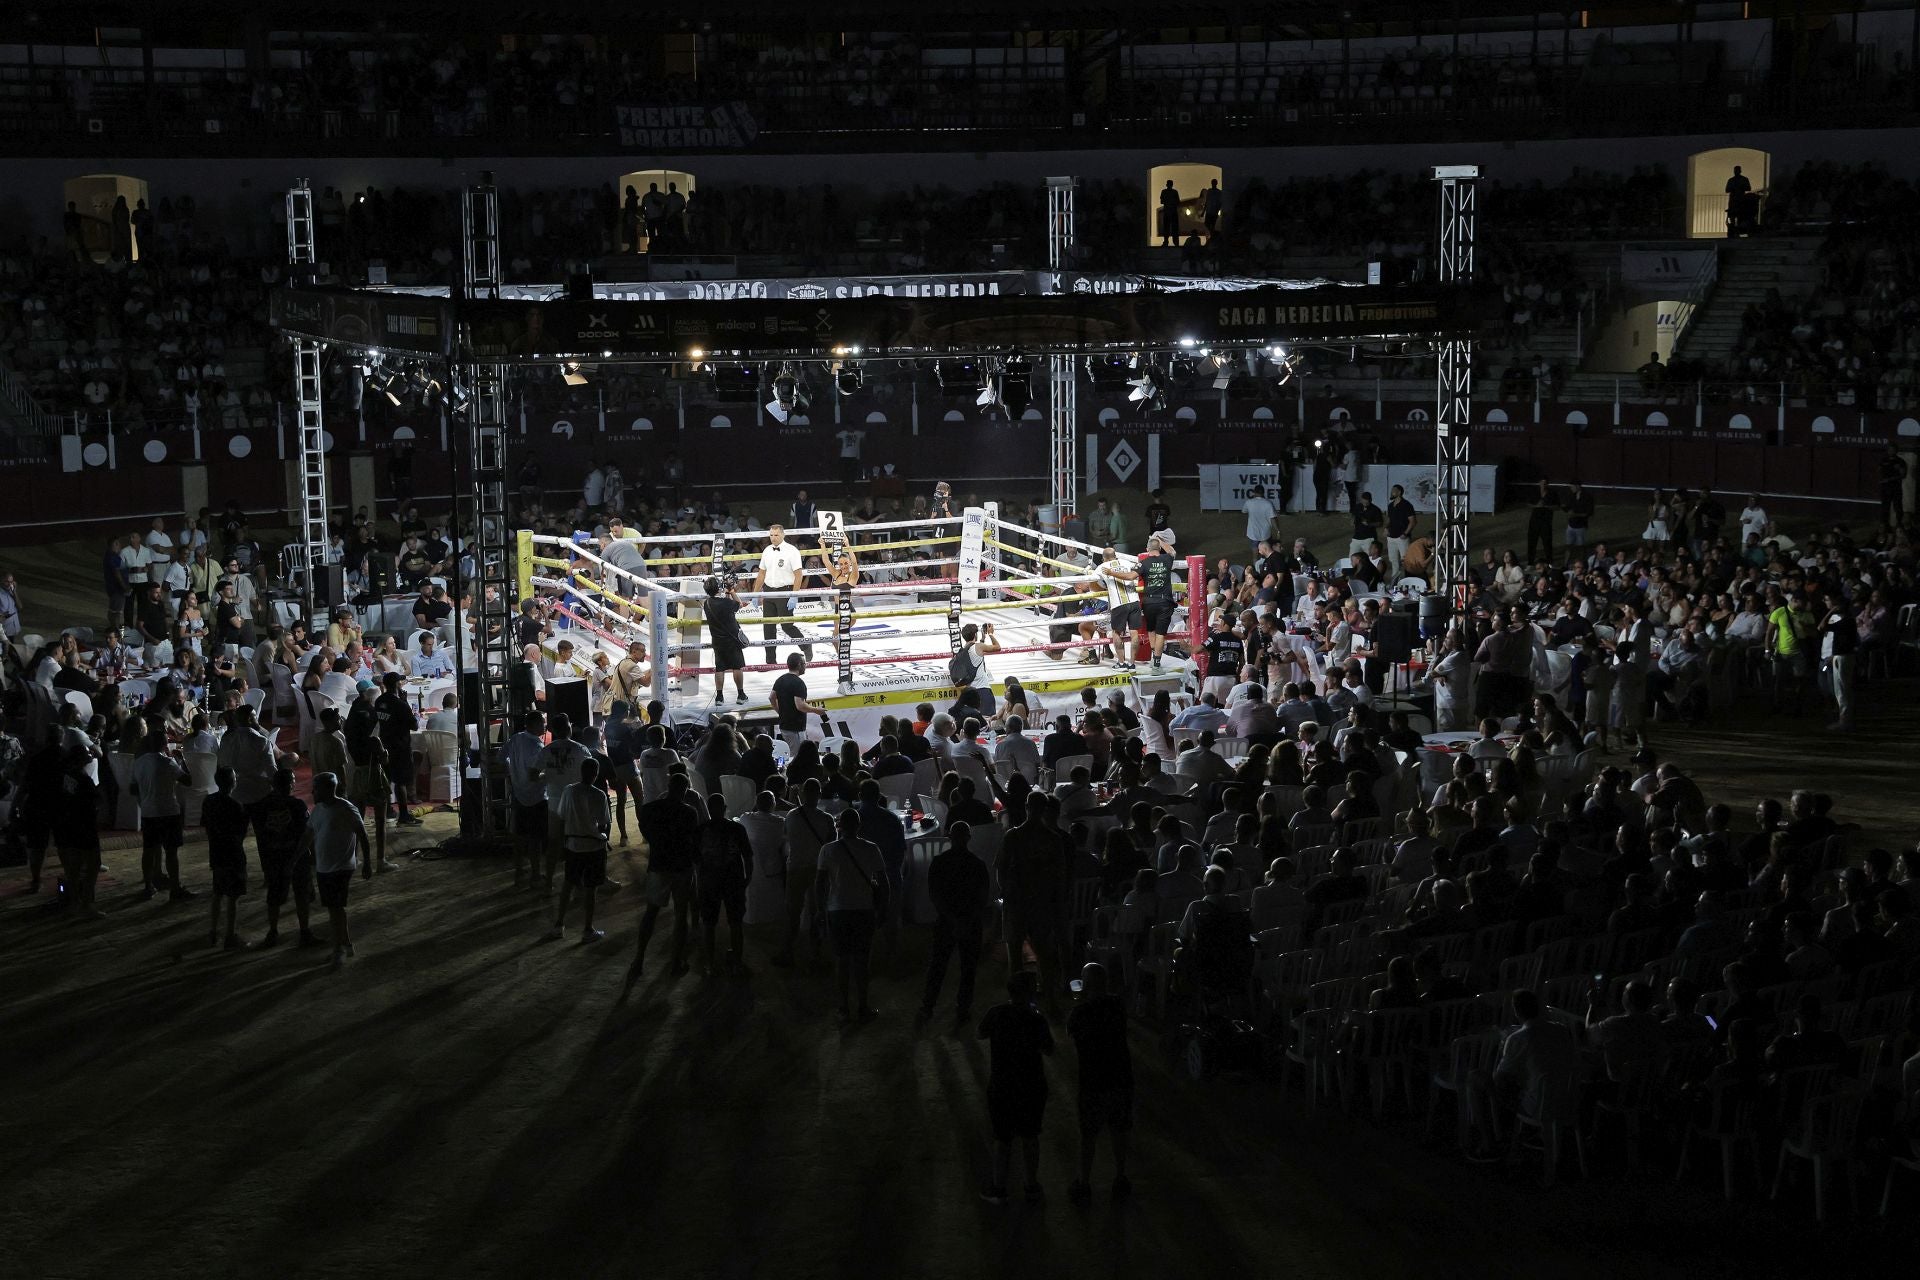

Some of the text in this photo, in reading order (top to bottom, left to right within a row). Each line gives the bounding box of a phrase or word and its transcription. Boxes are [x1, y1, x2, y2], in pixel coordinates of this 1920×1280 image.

[615, 105, 704, 127] FRENTE
[1218, 307, 1267, 326] SAGA
[1275, 304, 1355, 325] HEREDIA
[824, 512, 838, 531] 2
[966, 513, 982, 525] LEONE
[840, 602, 851, 677] SAGA HEREDIA
[1099, 676, 1119, 686] SAGA
[938, 689, 958, 699] SAGA
